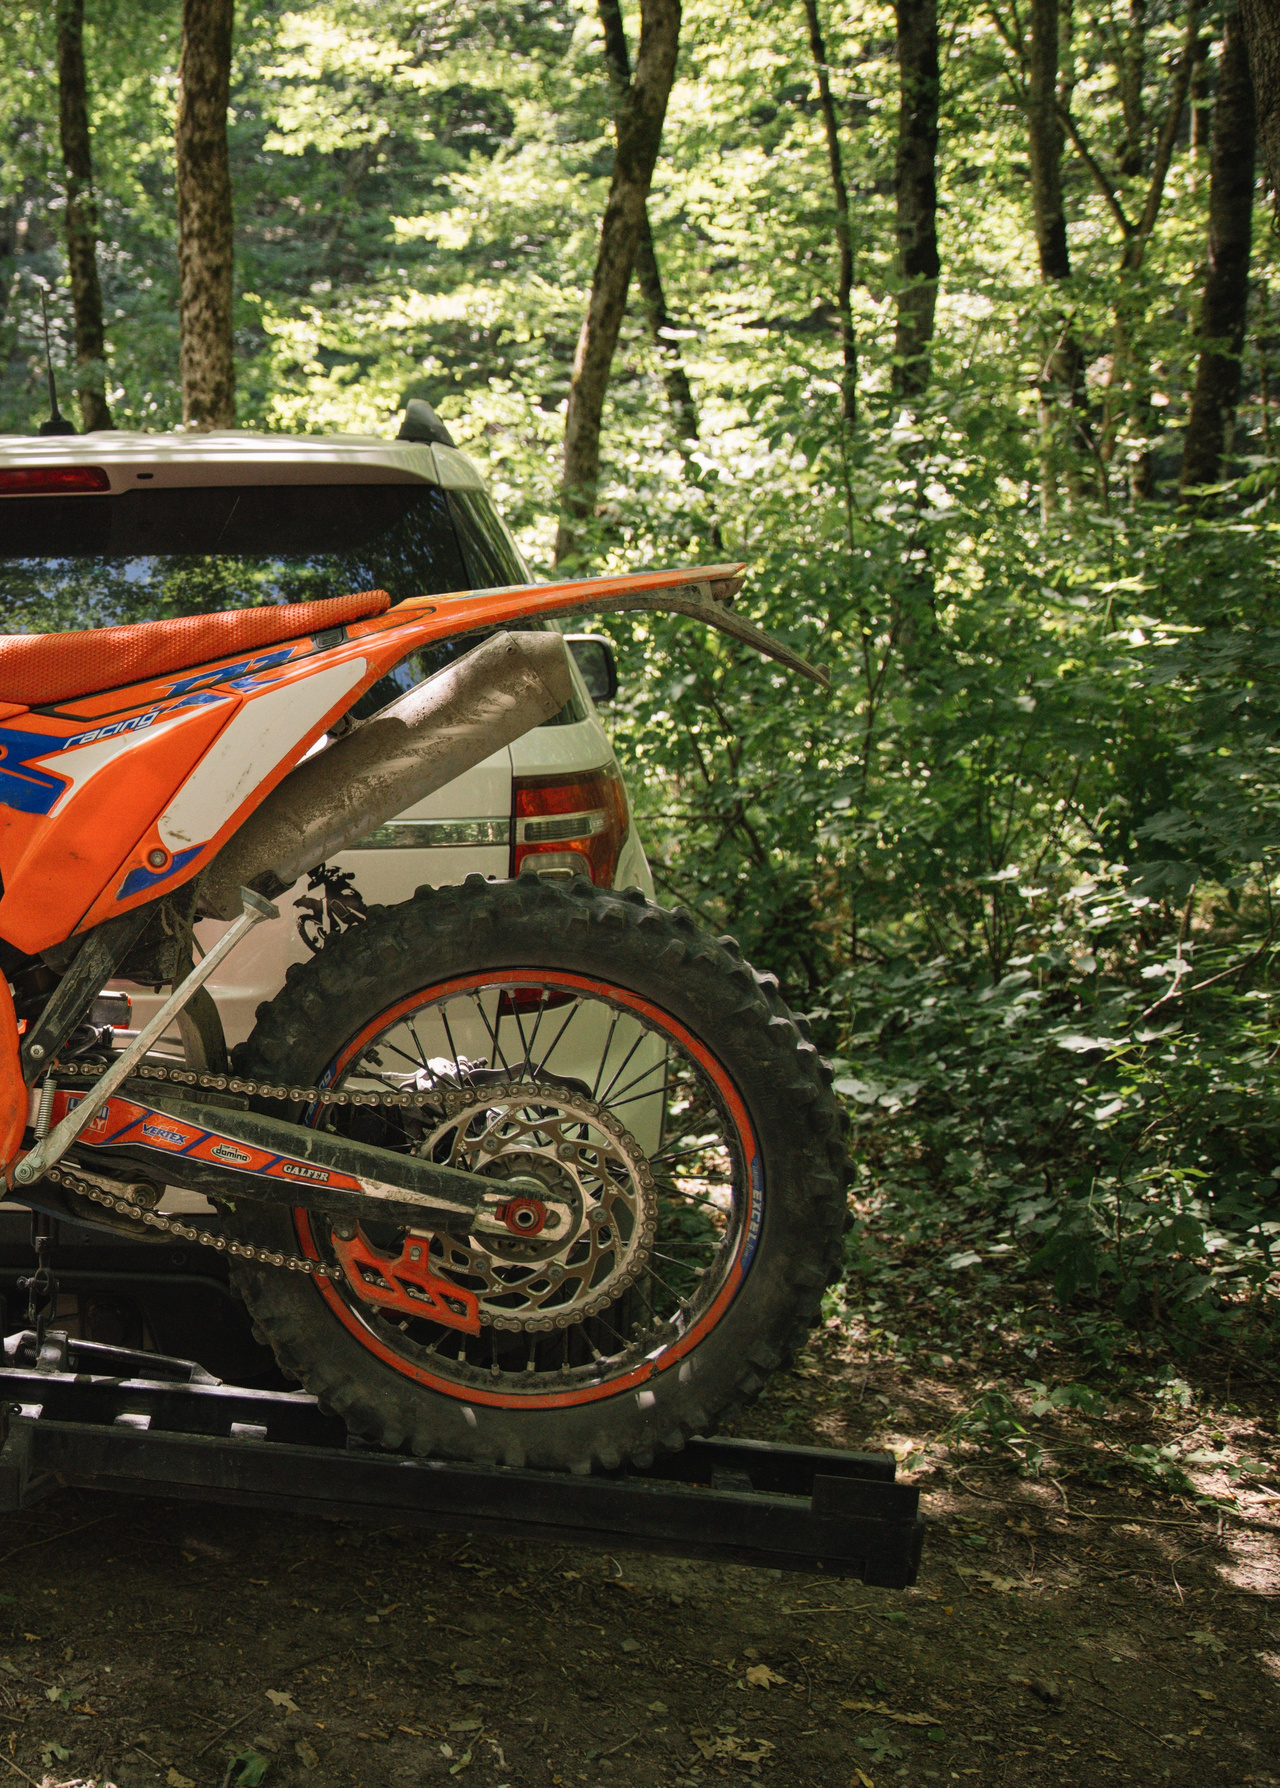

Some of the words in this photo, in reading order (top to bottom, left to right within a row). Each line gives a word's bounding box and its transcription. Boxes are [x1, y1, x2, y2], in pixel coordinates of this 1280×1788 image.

[63, 709, 159, 751] racing
[143, 1122, 188, 1144] VERTEX
[215, 1143, 248, 1162] domino
[283, 1164, 329, 1182] GALFER
[747, 1188, 762, 1241] EXCEL
